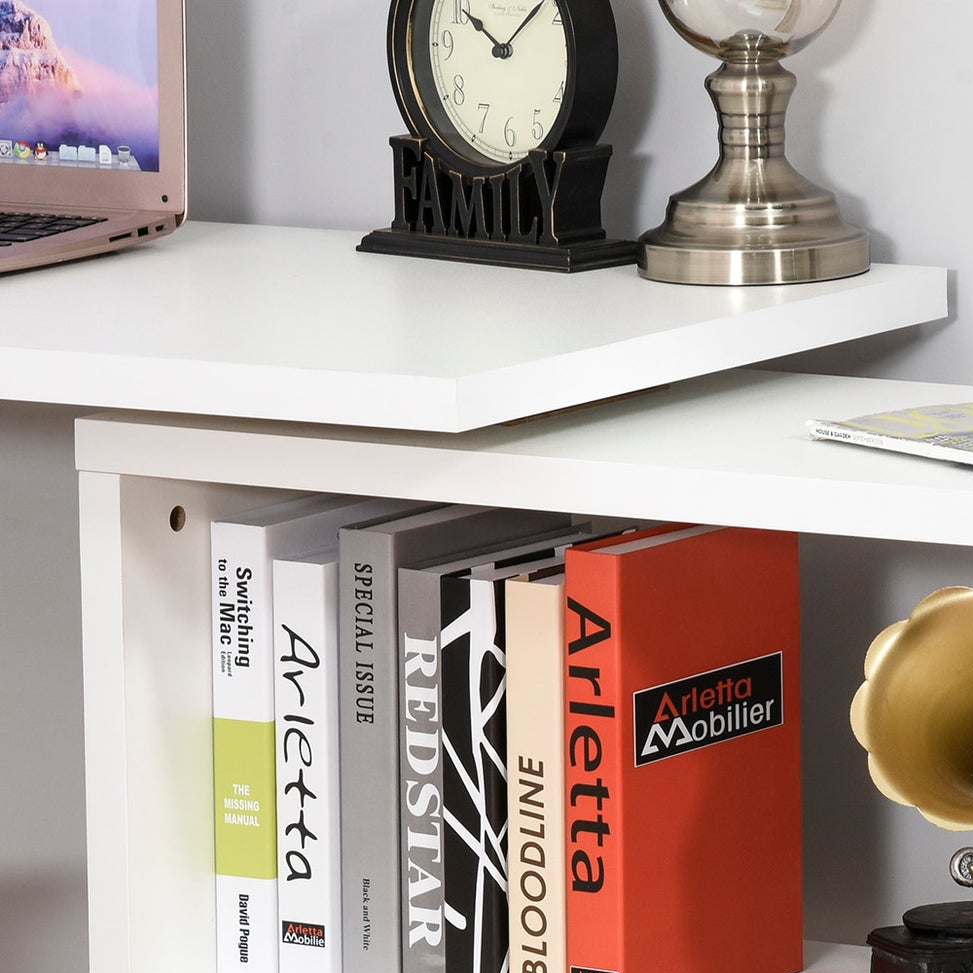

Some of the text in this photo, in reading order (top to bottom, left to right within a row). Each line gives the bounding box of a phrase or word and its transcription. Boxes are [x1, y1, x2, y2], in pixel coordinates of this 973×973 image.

[452, 0, 470, 25] 10
[442, 29, 454, 61] 9
[453, 74, 465, 106] 8
[477, 103, 490, 134] 7
[504, 116, 516, 148] 6
[531, 108, 544, 140] 5
[390, 138, 567, 245] FAMILY
[218, 558, 236, 645] to the Mac
[235, 567, 254, 668] Switching
[354, 562, 375, 724] SPECIAL ISSUE
[653, 673, 752, 723] Arletta
[566, 596, 616, 894] Arletta
[640, 698, 775, 757] Mobilier
[279, 623, 320, 881] Arletta
[224, 797, 260, 812] MISSING
[233, 784, 250, 796] THE
[404, 632, 443, 948] REDSTAR
[224, 813, 260, 827] MANUAL
[238, 893, 250, 964] David Pogue
[287, 923, 323, 937] Arletta
[362, 878, 371, 951] Black and White
[283, 931, 325, 947] Mobilie
